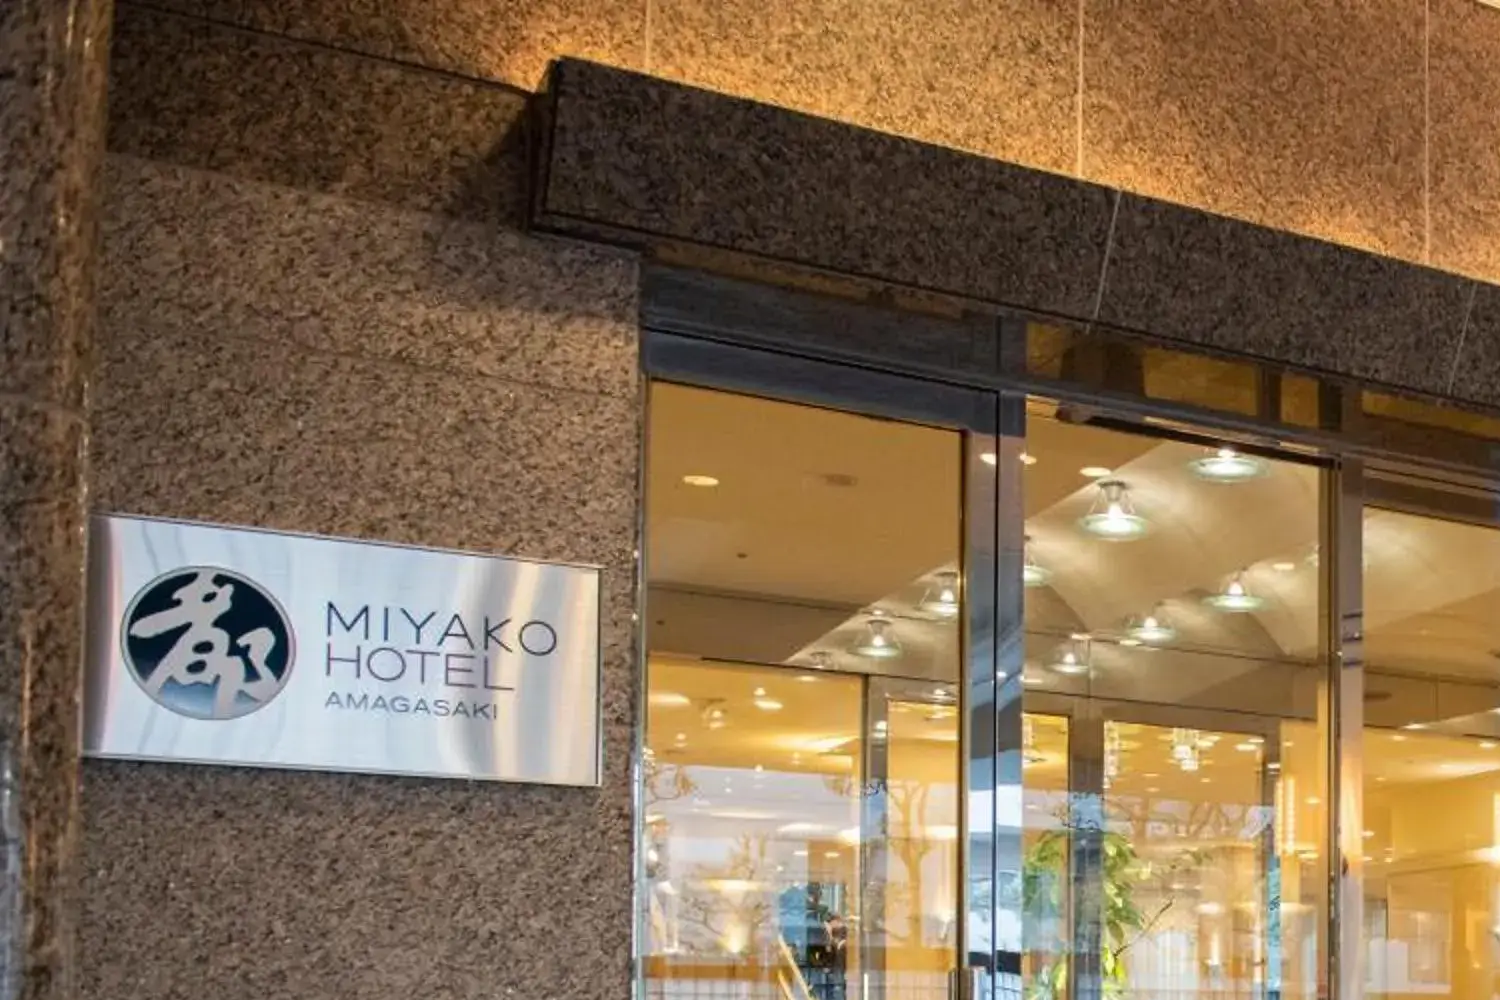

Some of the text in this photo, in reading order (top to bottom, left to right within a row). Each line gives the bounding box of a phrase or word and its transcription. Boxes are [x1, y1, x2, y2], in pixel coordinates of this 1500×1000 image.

[325, 601, 558, 657] MIYAKO
[325, 644, 515, 691] HOTEL
[324, 691, 498, 720] AMAGASAKI
